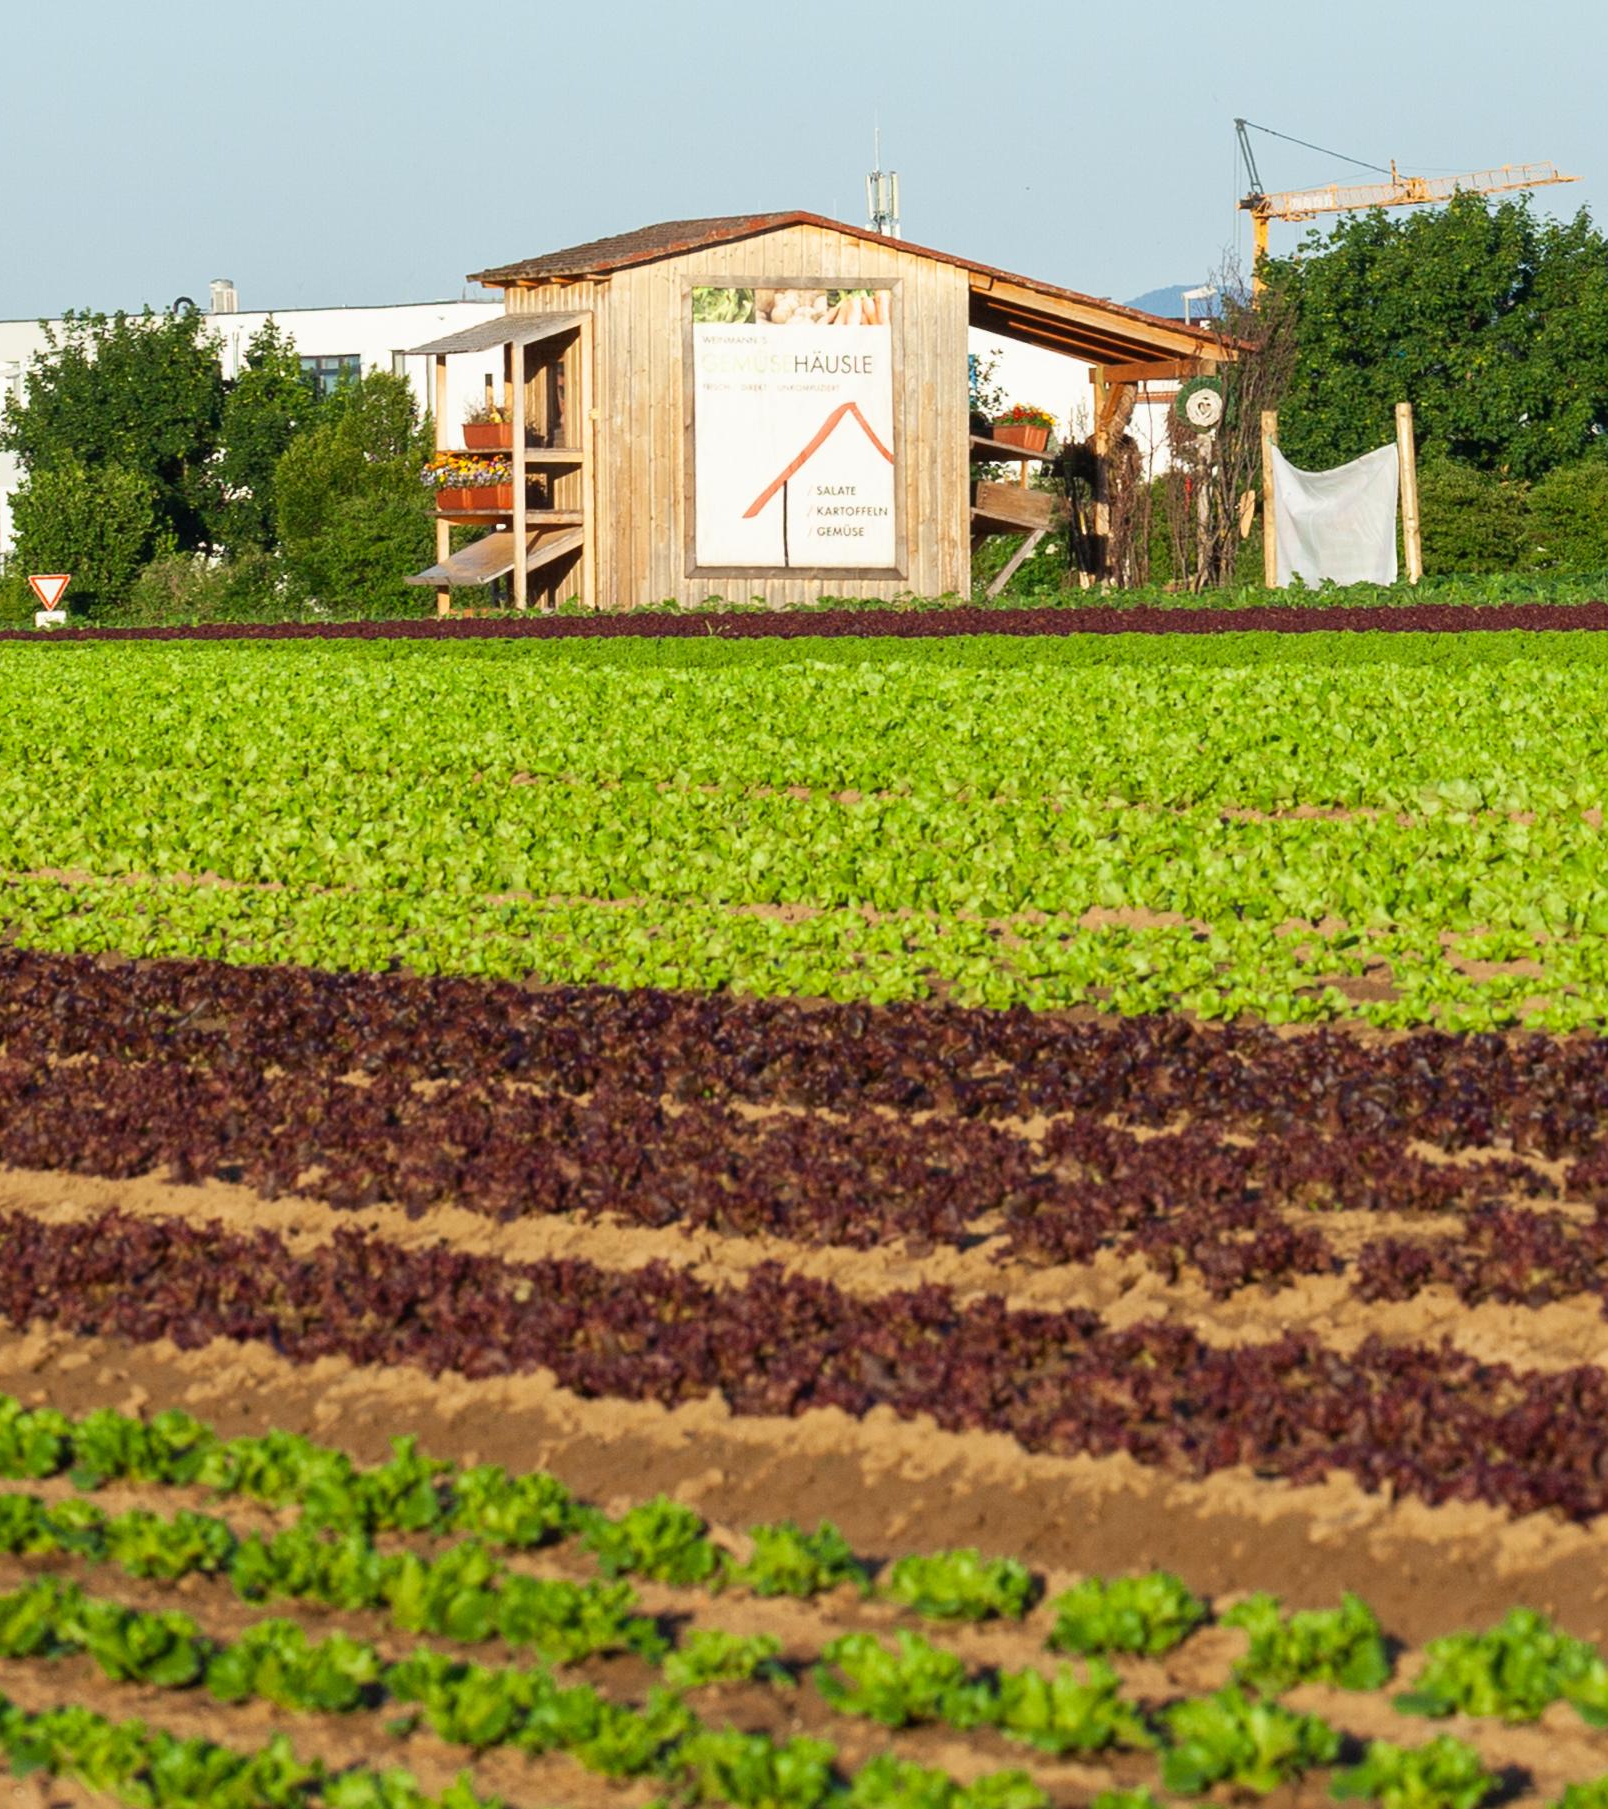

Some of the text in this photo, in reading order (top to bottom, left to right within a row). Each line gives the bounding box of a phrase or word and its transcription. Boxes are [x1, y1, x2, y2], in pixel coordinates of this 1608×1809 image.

[702, 336, 768, 344] WEINMANNS
[817, 486, 856, 496] SALATE
[817, 506, 888, 516] KARTOFFELN
[817, 524, 864, 536] GEMÜSE
